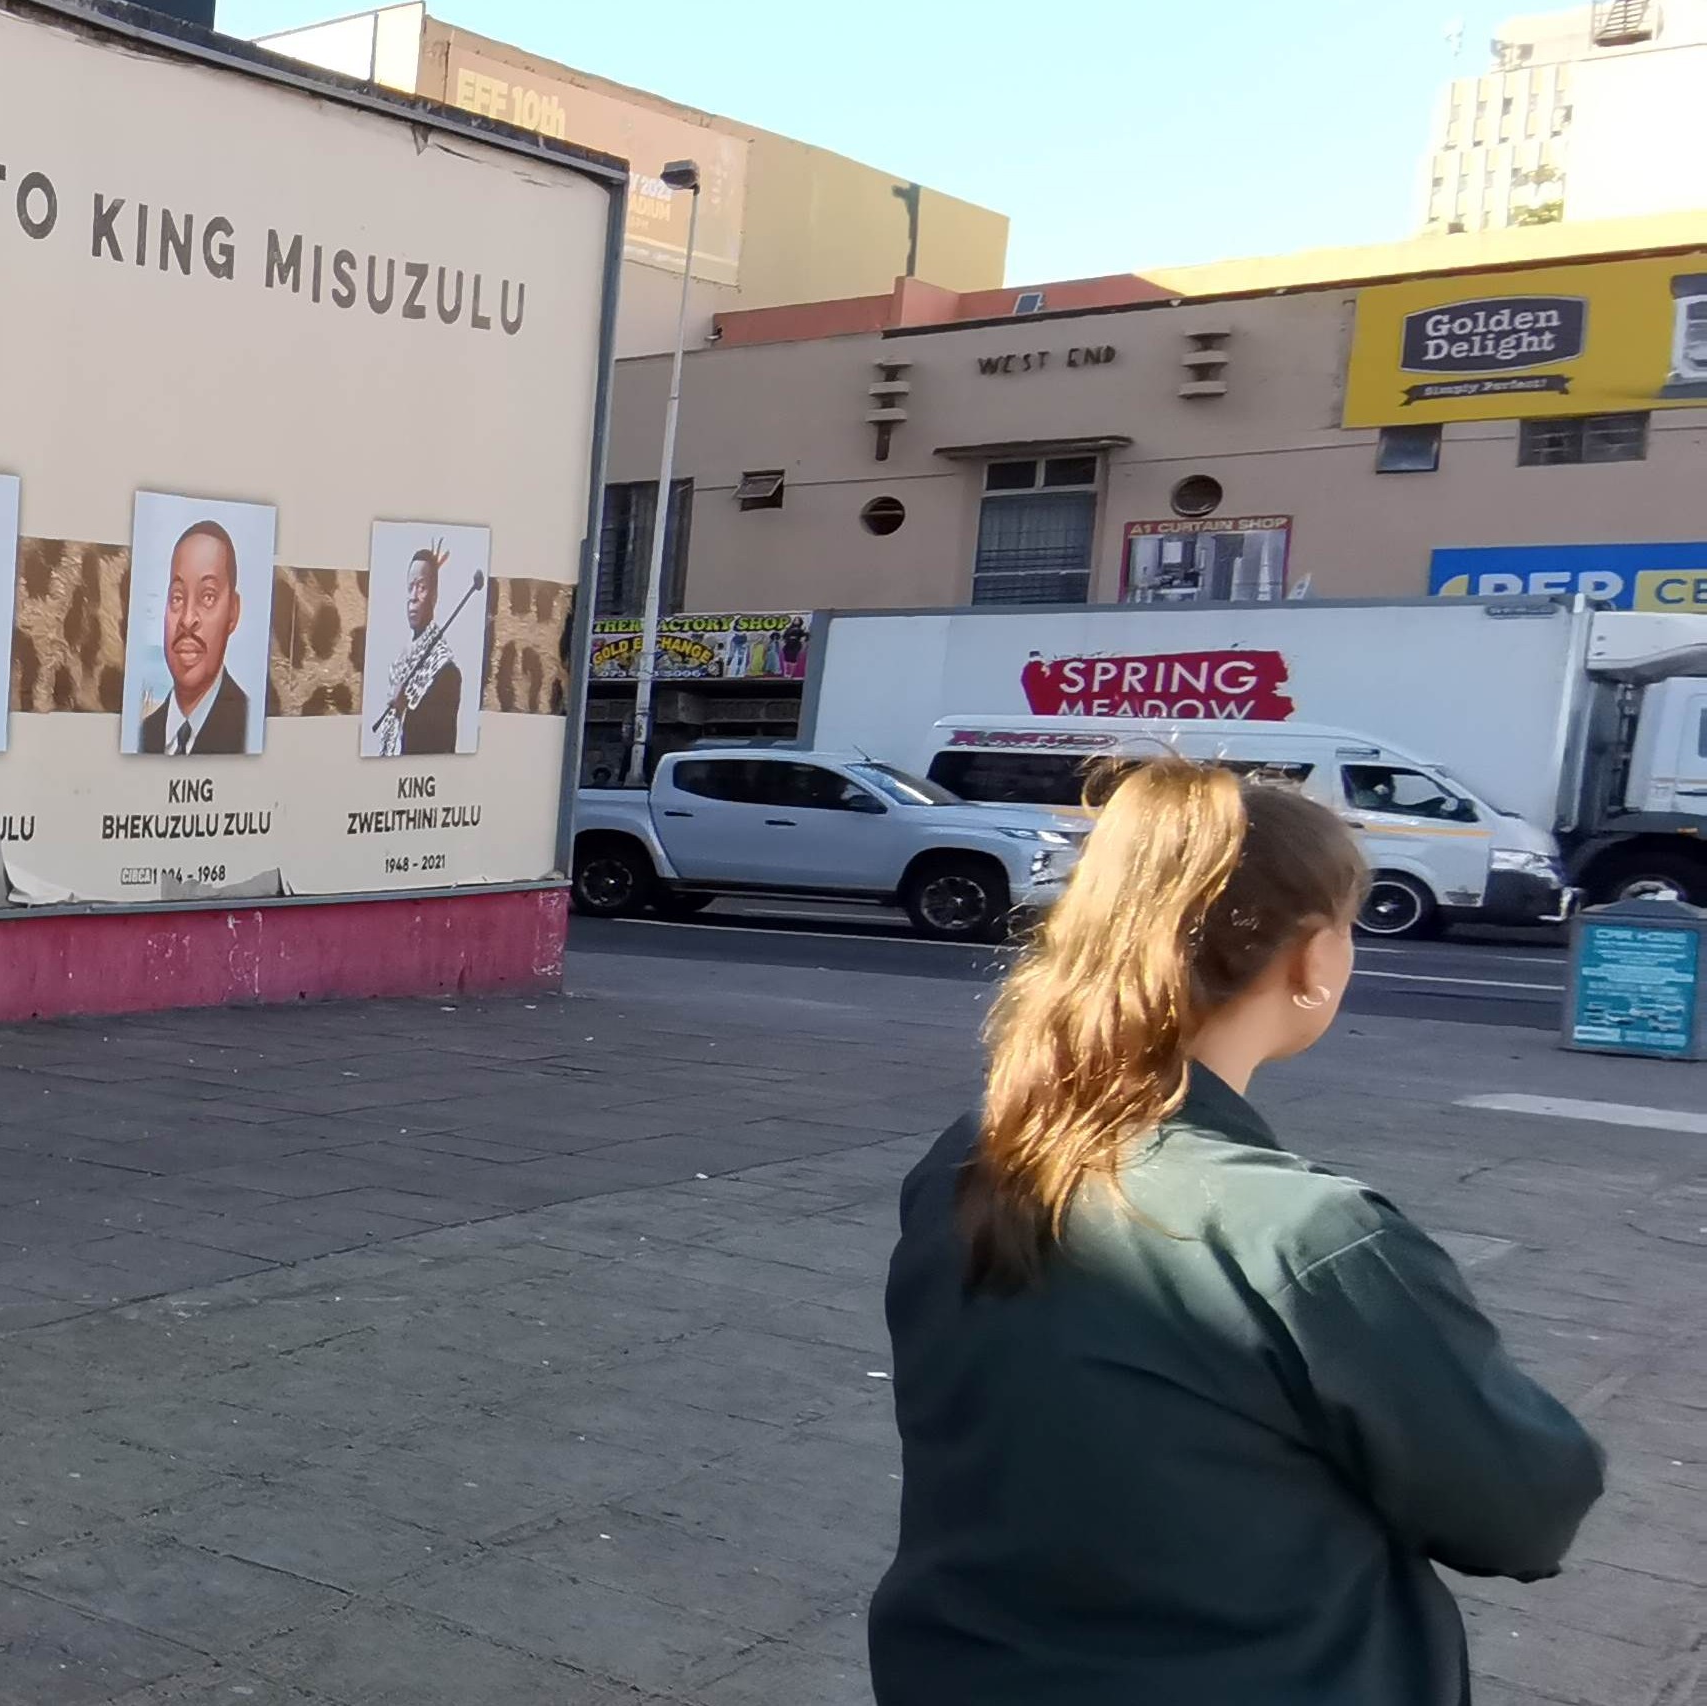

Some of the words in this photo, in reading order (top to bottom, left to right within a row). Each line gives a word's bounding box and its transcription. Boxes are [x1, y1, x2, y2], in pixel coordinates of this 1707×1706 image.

[457, 68, 508, 117] EFF
[92, 193, 234, 280] KING
[265, 229, 524, 335] MISUZULU
[1425, 309, 1561, 337] Golden
[1422, 331, 1557, 361] Delight
[977, 351, 1050, 374] WEST
[1067, 346, 1116, 367] END
[1238, 517, 1288, 530] SHOP
[737, 617, 791, 631] SHOP
[593, 641, 628, 666] GOLD
[1059, 661, 1258, 694] SPRING
[169, 779, 213, 803] KING
[398, 776, 435, 798] KING
[102, 814, 218, 839] BHEKUZULU
[224, 812, 271, 836] ZULU
[347, 810, 437, 834] ZWELITHINI
[441, 806, 481, 828] ZULU
[198, 865, 226, 882] 1968
[385, 857, 410, 872] 1948
[422, 855, 446, 870] 2021
